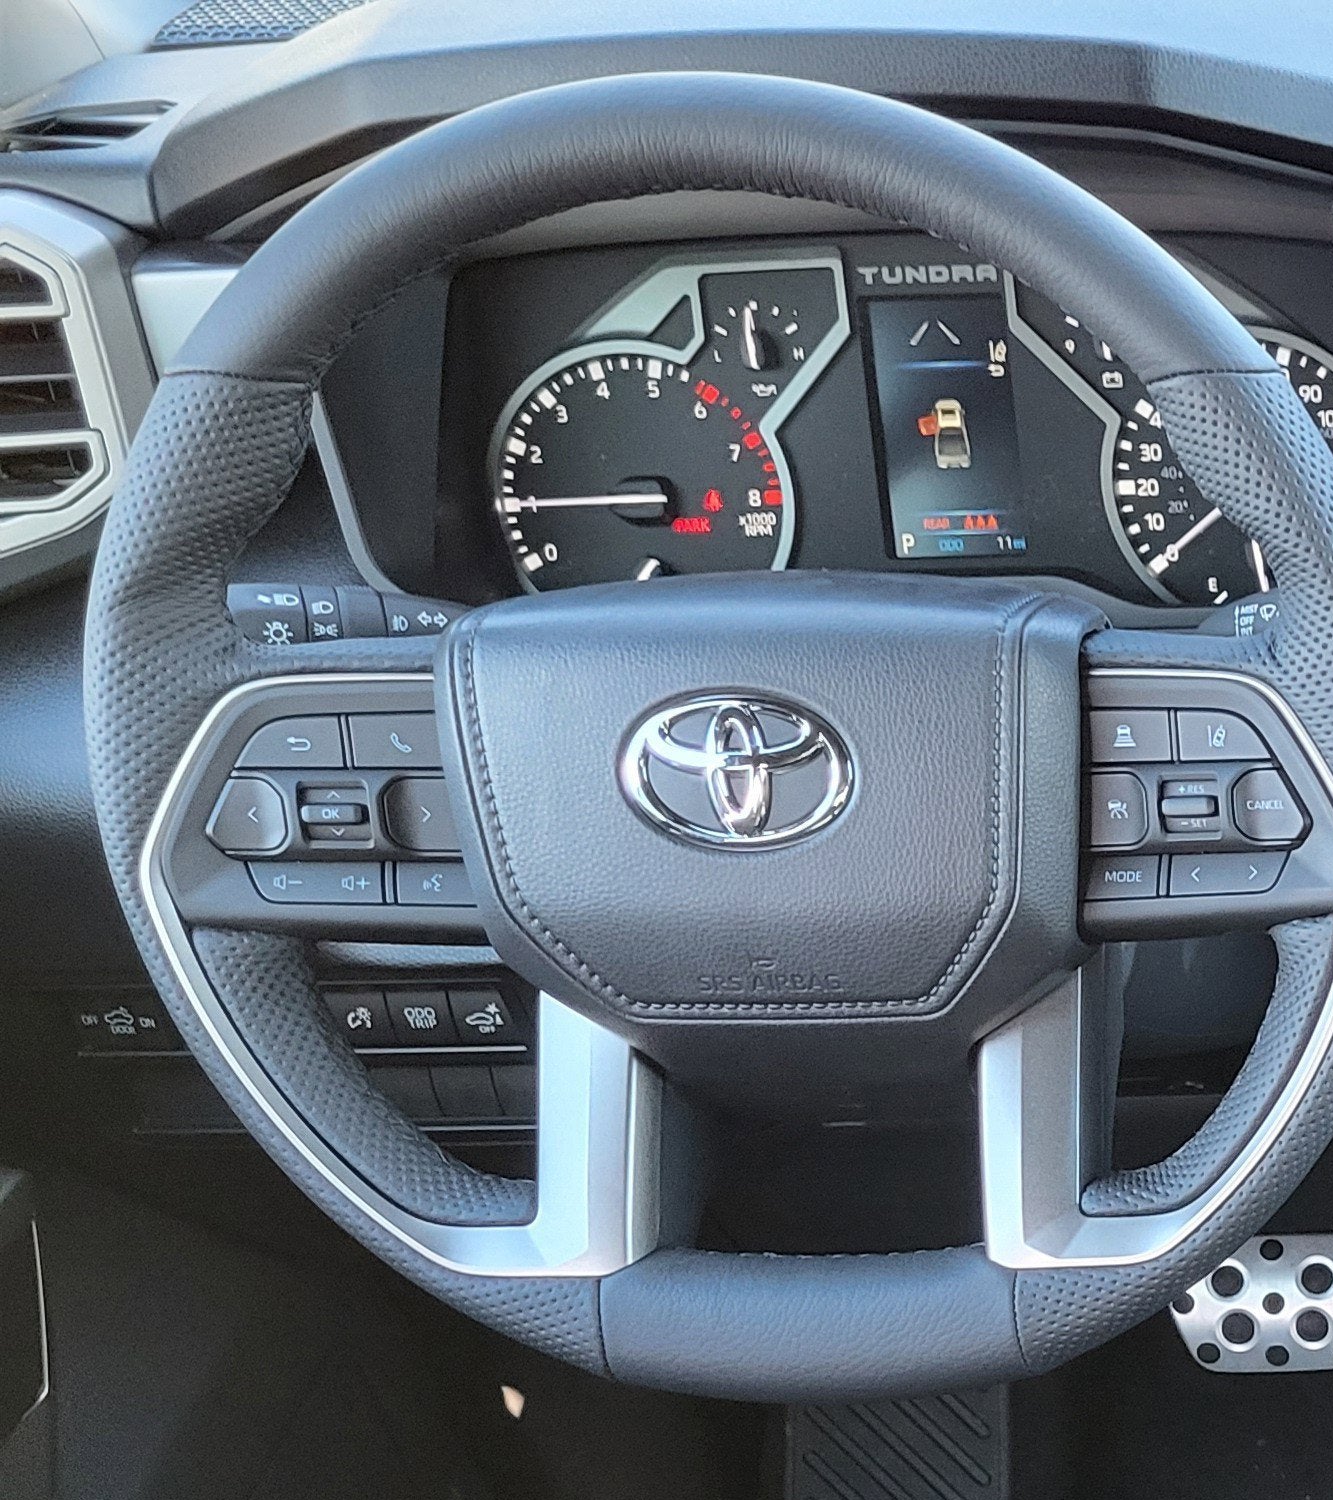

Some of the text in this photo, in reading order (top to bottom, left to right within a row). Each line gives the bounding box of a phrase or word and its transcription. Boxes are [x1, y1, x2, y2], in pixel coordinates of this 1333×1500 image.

[856, 264, 998, 285] TUNDRA
[596, 381, 610, 400] 4
[648, 380, 661, 399] 5
[1298, 384, 1323, 404] 90
[555, 405, 569, 424] 3
[693, 401, 708, 420] 6
[530, 445, 543, 464] 2
[729, 443, 741, 462] 7
[1139, 443, 1162, 462] 30
[1137, 478, 1160, 497] 20
[749, 489, 761, 507] 8
[1143, 513, 1165, 532] 10
[544, 543, 558, 562] 0
[901, 533, 915, 555] P
[1207, 577, 1218, 592] E
[1240, 615, 1255, 627] OFF
[322, 808, 340, 819] OK
[1246, 800, 1284, 811] CANCEL
[1104, 871, 1143, 882] MODE
[698, 972, 844, 994] SRS AIRBAG
[403, 1007, 436, 1019] ODO
[409, 1018, 438, 1029] TRIP
